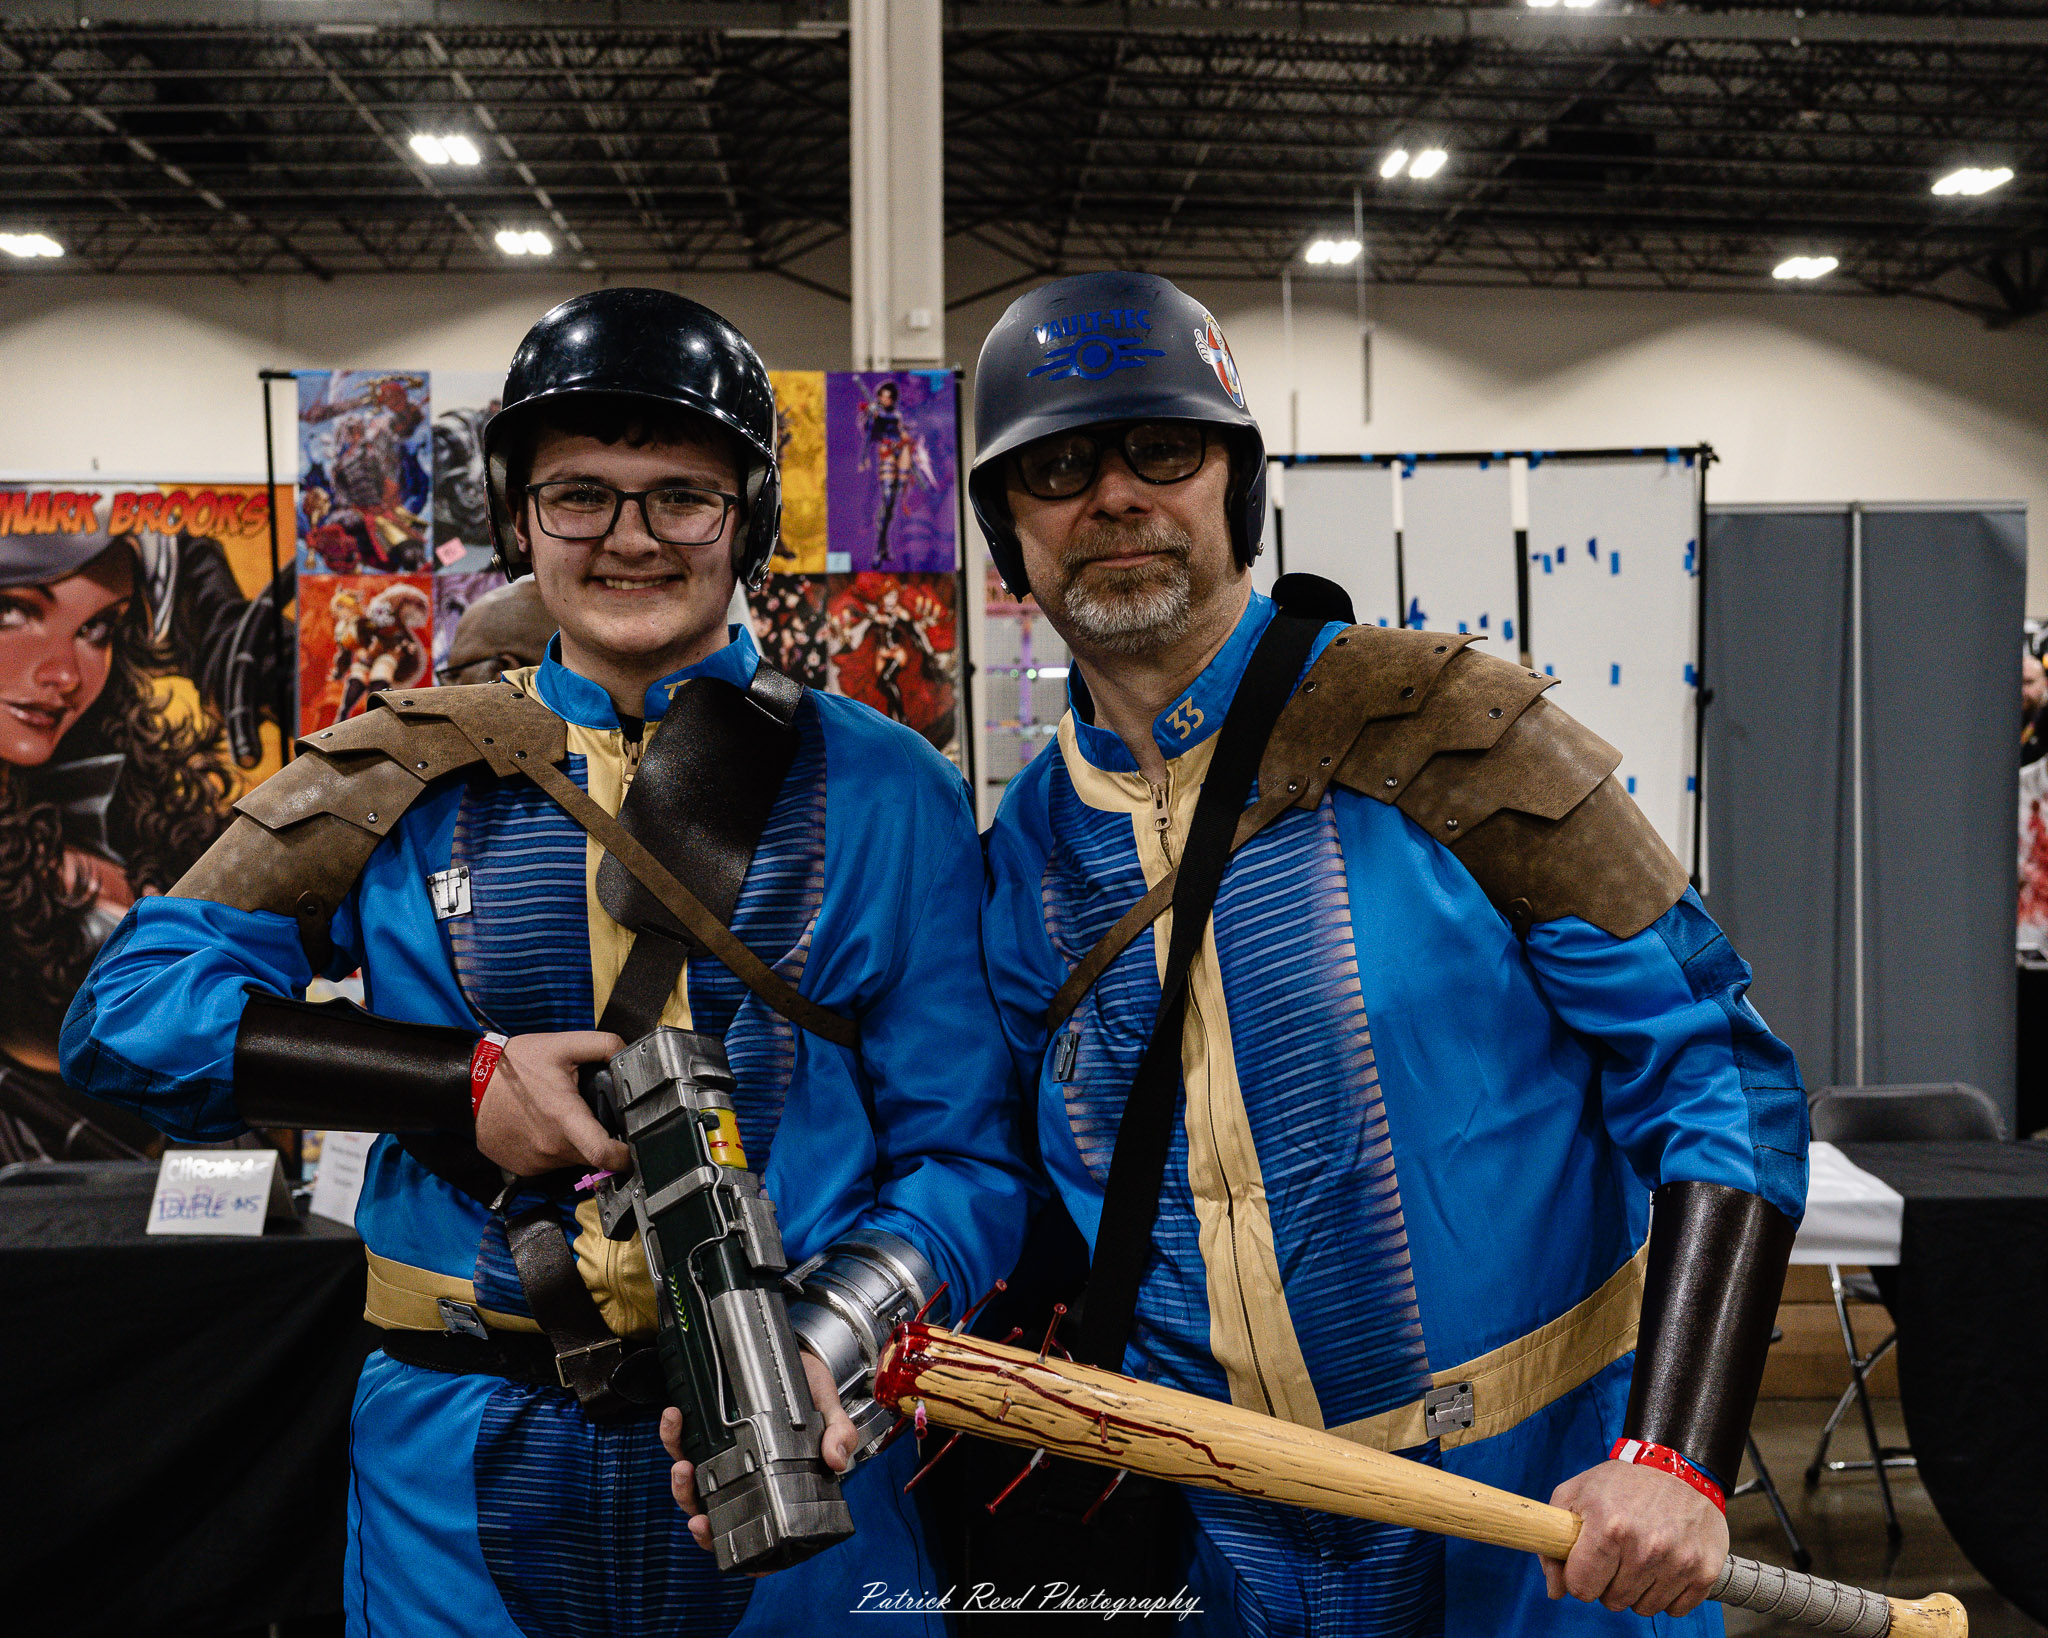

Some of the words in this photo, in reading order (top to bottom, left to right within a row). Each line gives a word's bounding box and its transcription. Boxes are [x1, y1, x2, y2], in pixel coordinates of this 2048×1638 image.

[1033, 309, 1151, 344] VAULT-TEC
[0, 490, 102, 538] MARK
[108, 490, 270, 540] BROOKS
[1165, 696, 1205, 740] 33
